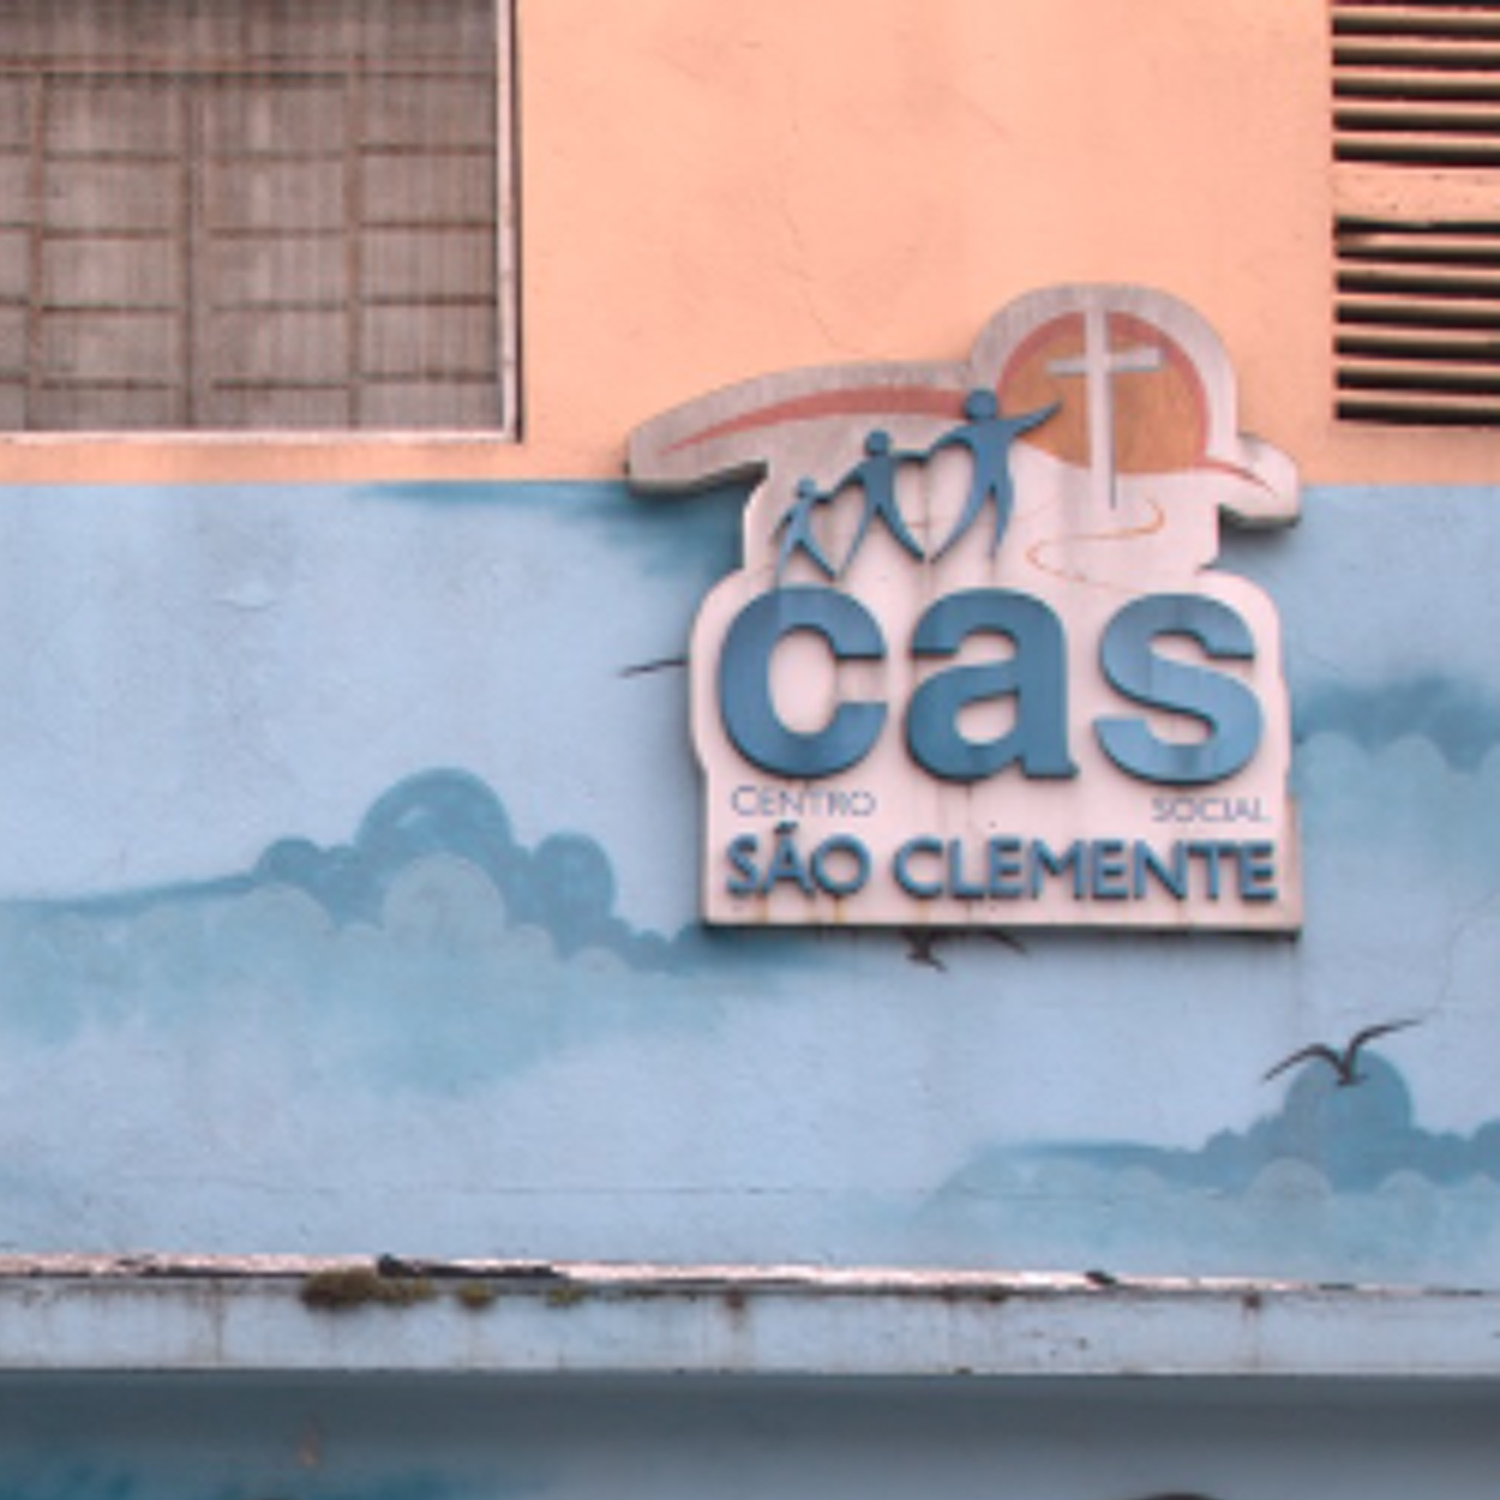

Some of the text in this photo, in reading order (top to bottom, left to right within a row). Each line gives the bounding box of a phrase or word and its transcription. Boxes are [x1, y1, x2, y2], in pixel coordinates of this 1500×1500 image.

[718, 585, 1263, 785] cas
[731, 786, 1270, 823] CENTRO SOCIAL
[725, 821, 1278, 902] SÃO CLEMENTE
